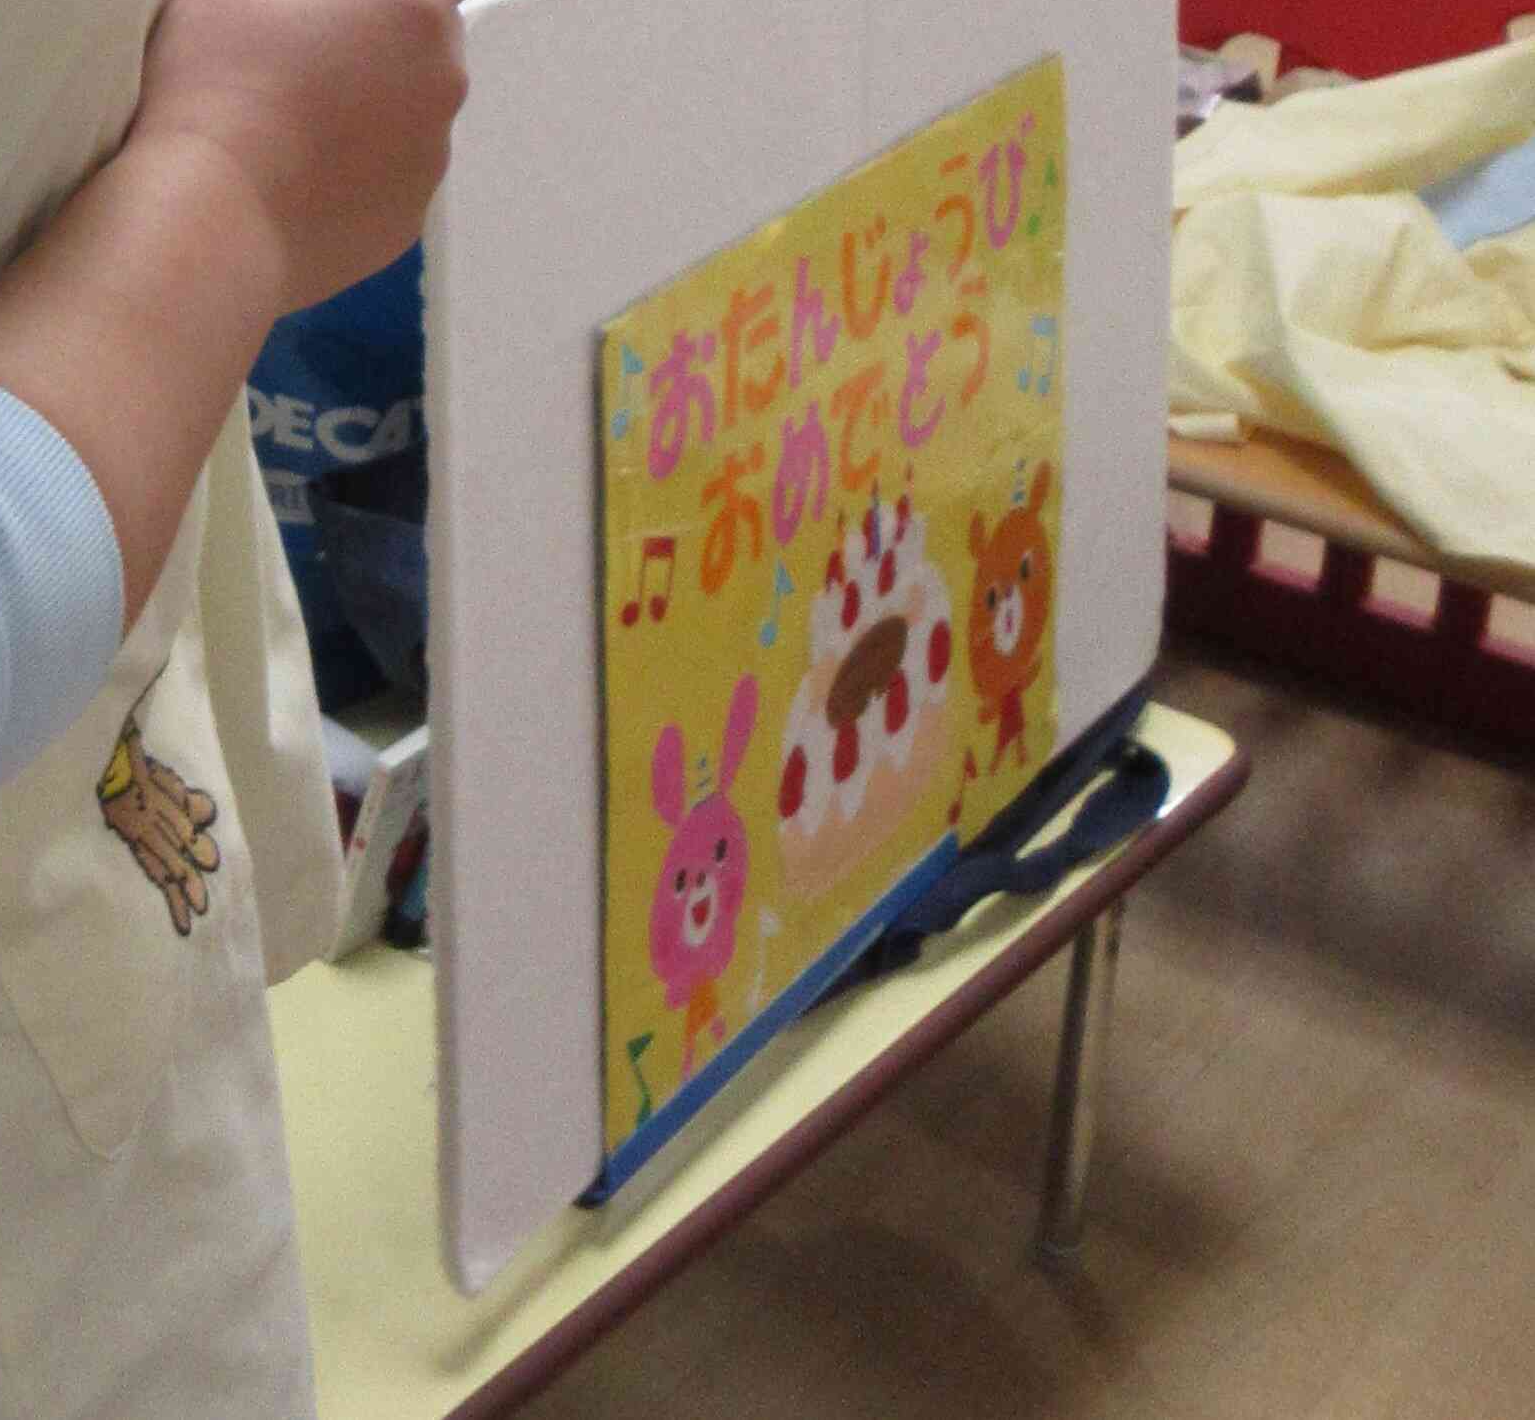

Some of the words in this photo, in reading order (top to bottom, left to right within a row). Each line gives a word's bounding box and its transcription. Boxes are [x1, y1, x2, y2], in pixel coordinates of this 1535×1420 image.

[647, 111, 1036, 482] おたんじょうび
[699, 275, 990, 597] おめでとう
